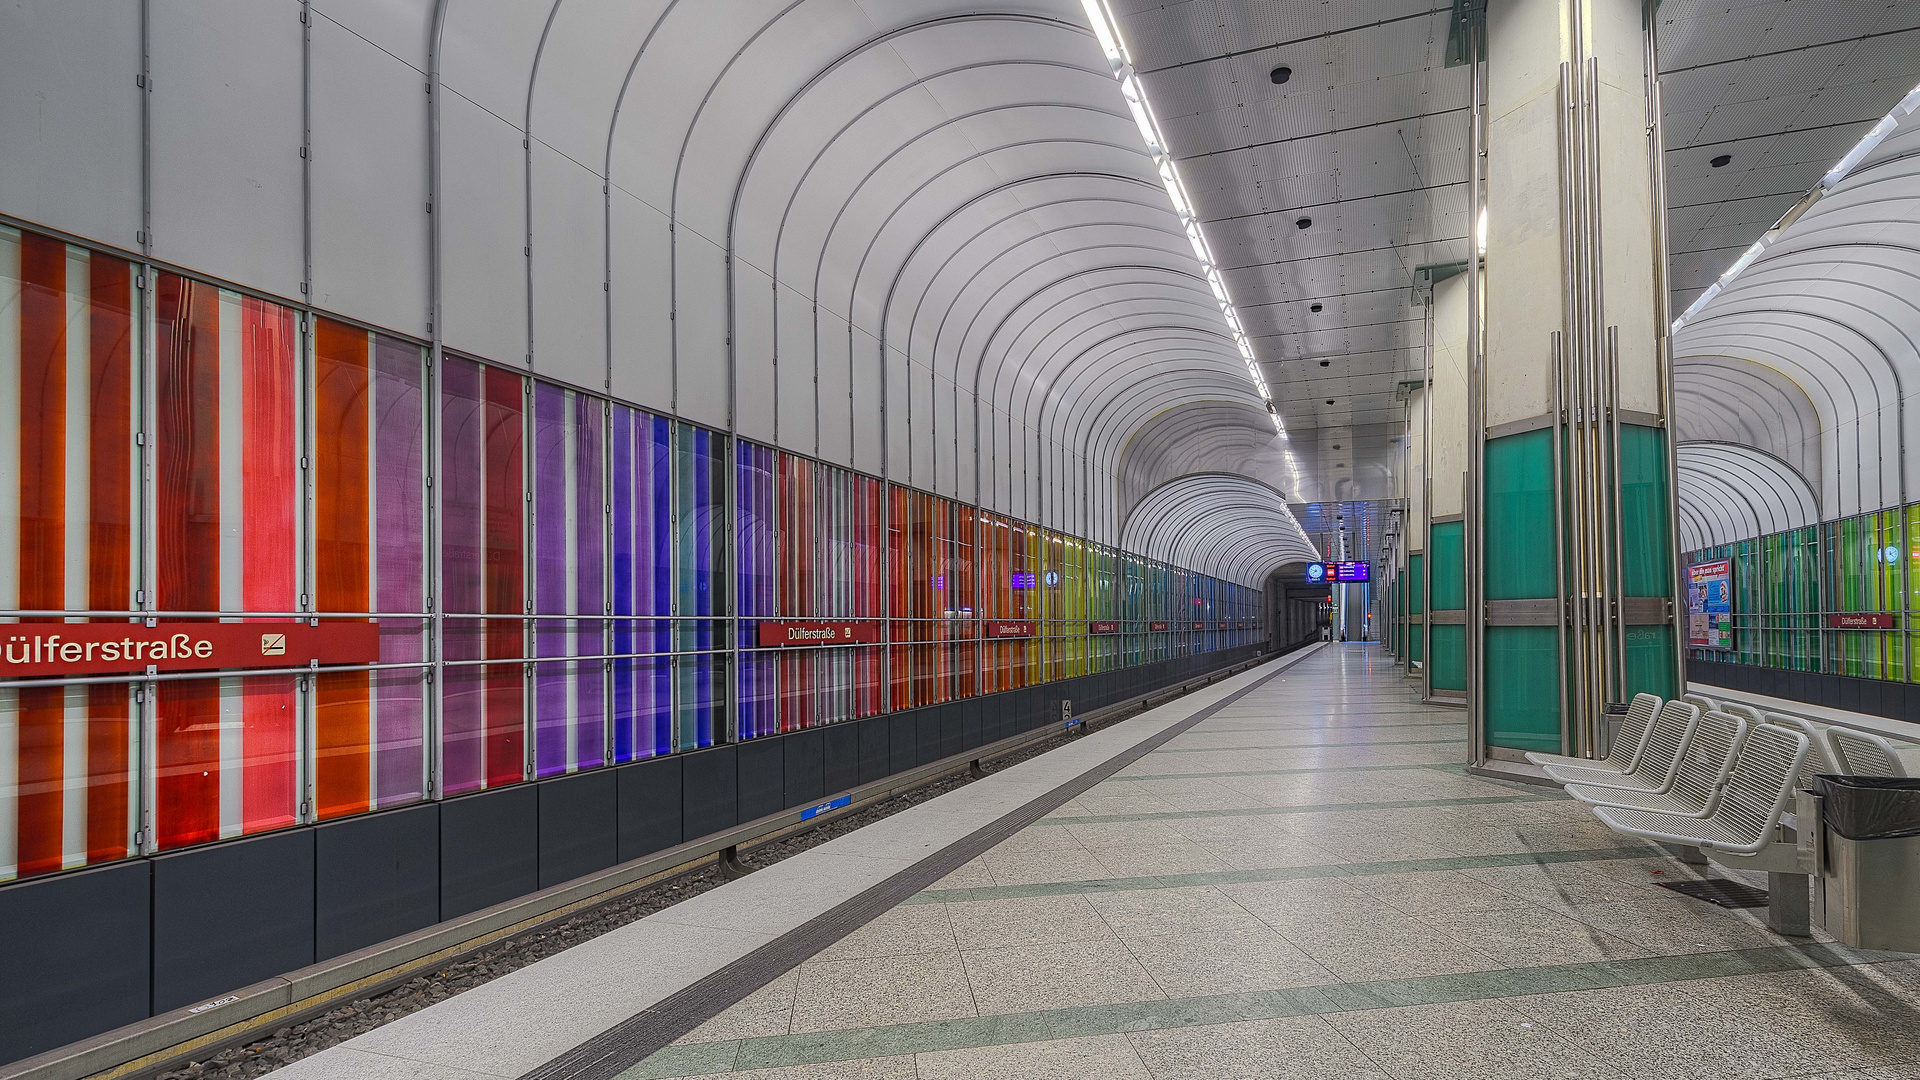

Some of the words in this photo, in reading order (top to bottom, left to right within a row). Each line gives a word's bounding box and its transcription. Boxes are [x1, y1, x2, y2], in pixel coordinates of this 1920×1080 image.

[1841, 617, 1867, 625] Dülferstraße
[788, 627, 836, 640] Dülferstraße
[0, 633, 213, 664] ülferstraße
[1064, 701, 1071, 713] 4
